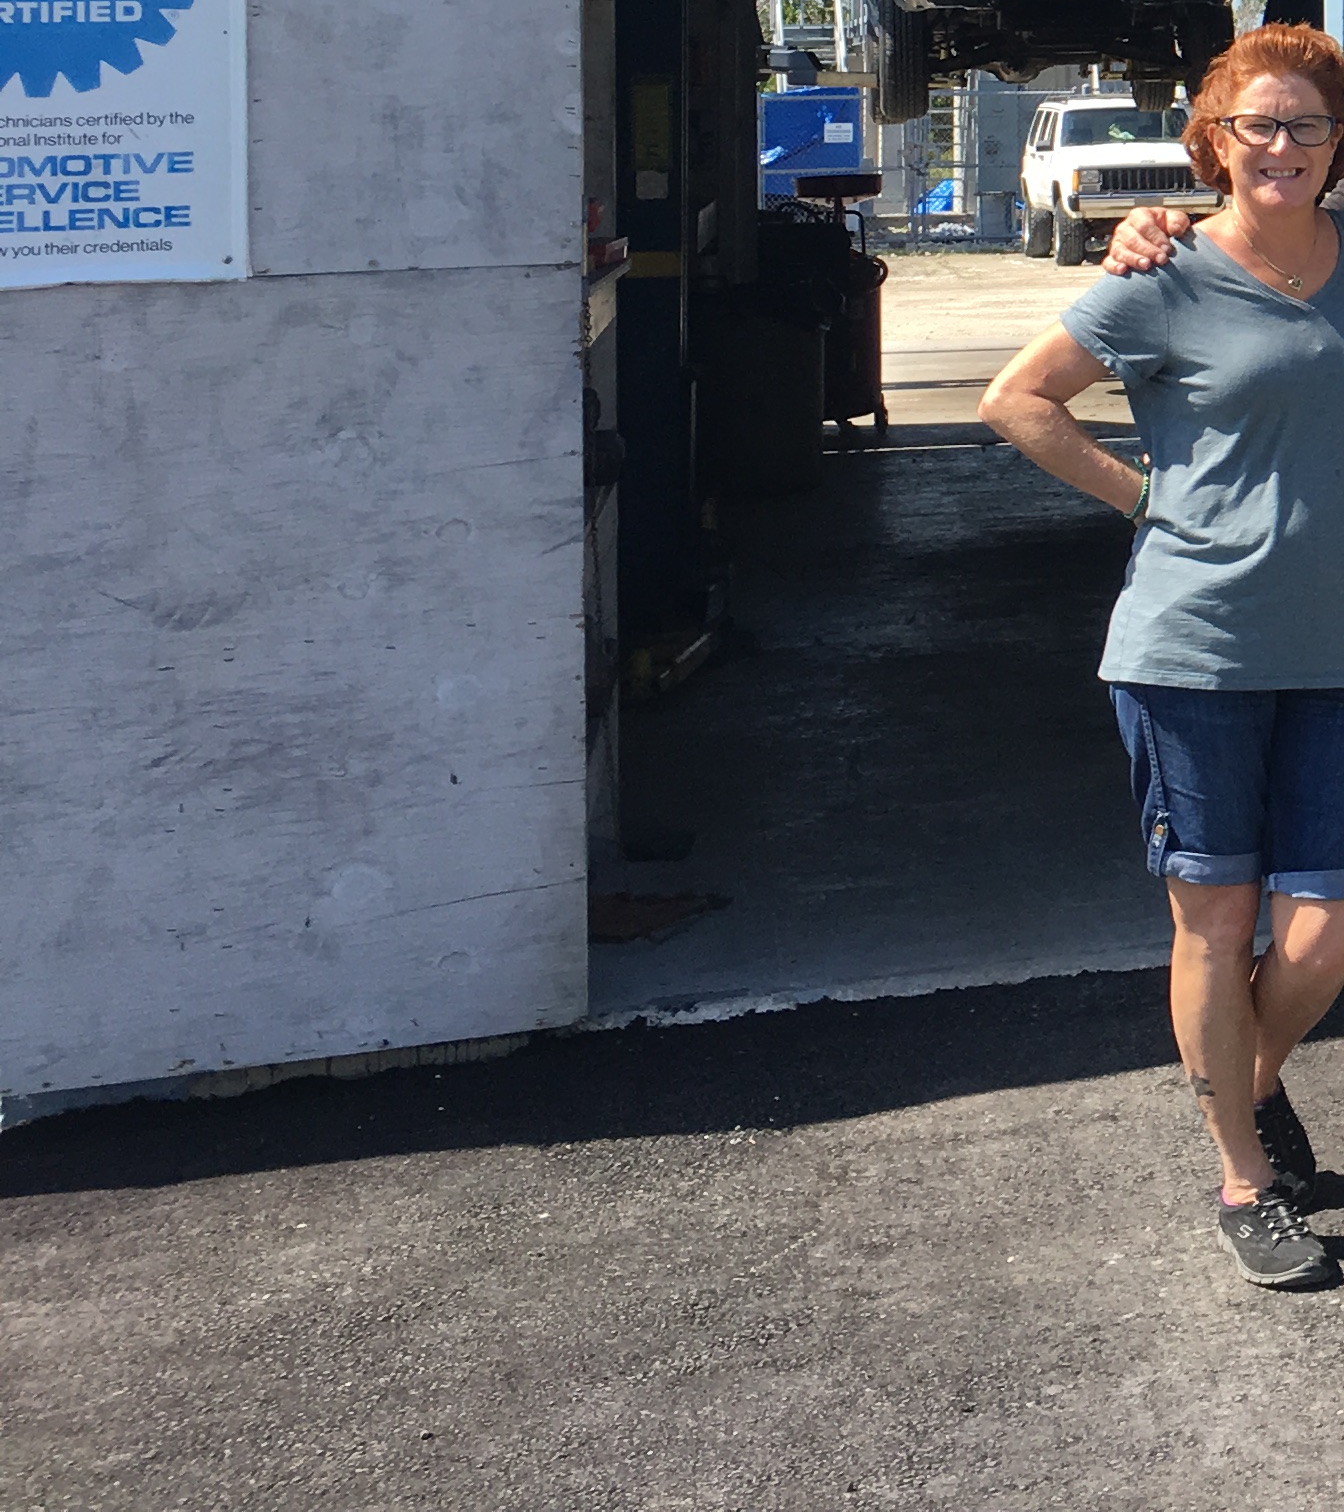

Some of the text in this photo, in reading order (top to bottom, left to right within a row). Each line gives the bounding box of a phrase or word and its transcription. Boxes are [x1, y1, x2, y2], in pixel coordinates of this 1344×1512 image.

[75, 112, 144, 127] certified
[146, 112, 167, 128] by
[169, 111, 195, 125] the
[34, 132, 99, 147] Institute
[102, 131, 124, 146] for
[0, 180, 141, 207] RVICE
[12, 244, 42, 260] you
[45, 240, 81, 256] their
[83, 238, 174, 255] credentials
